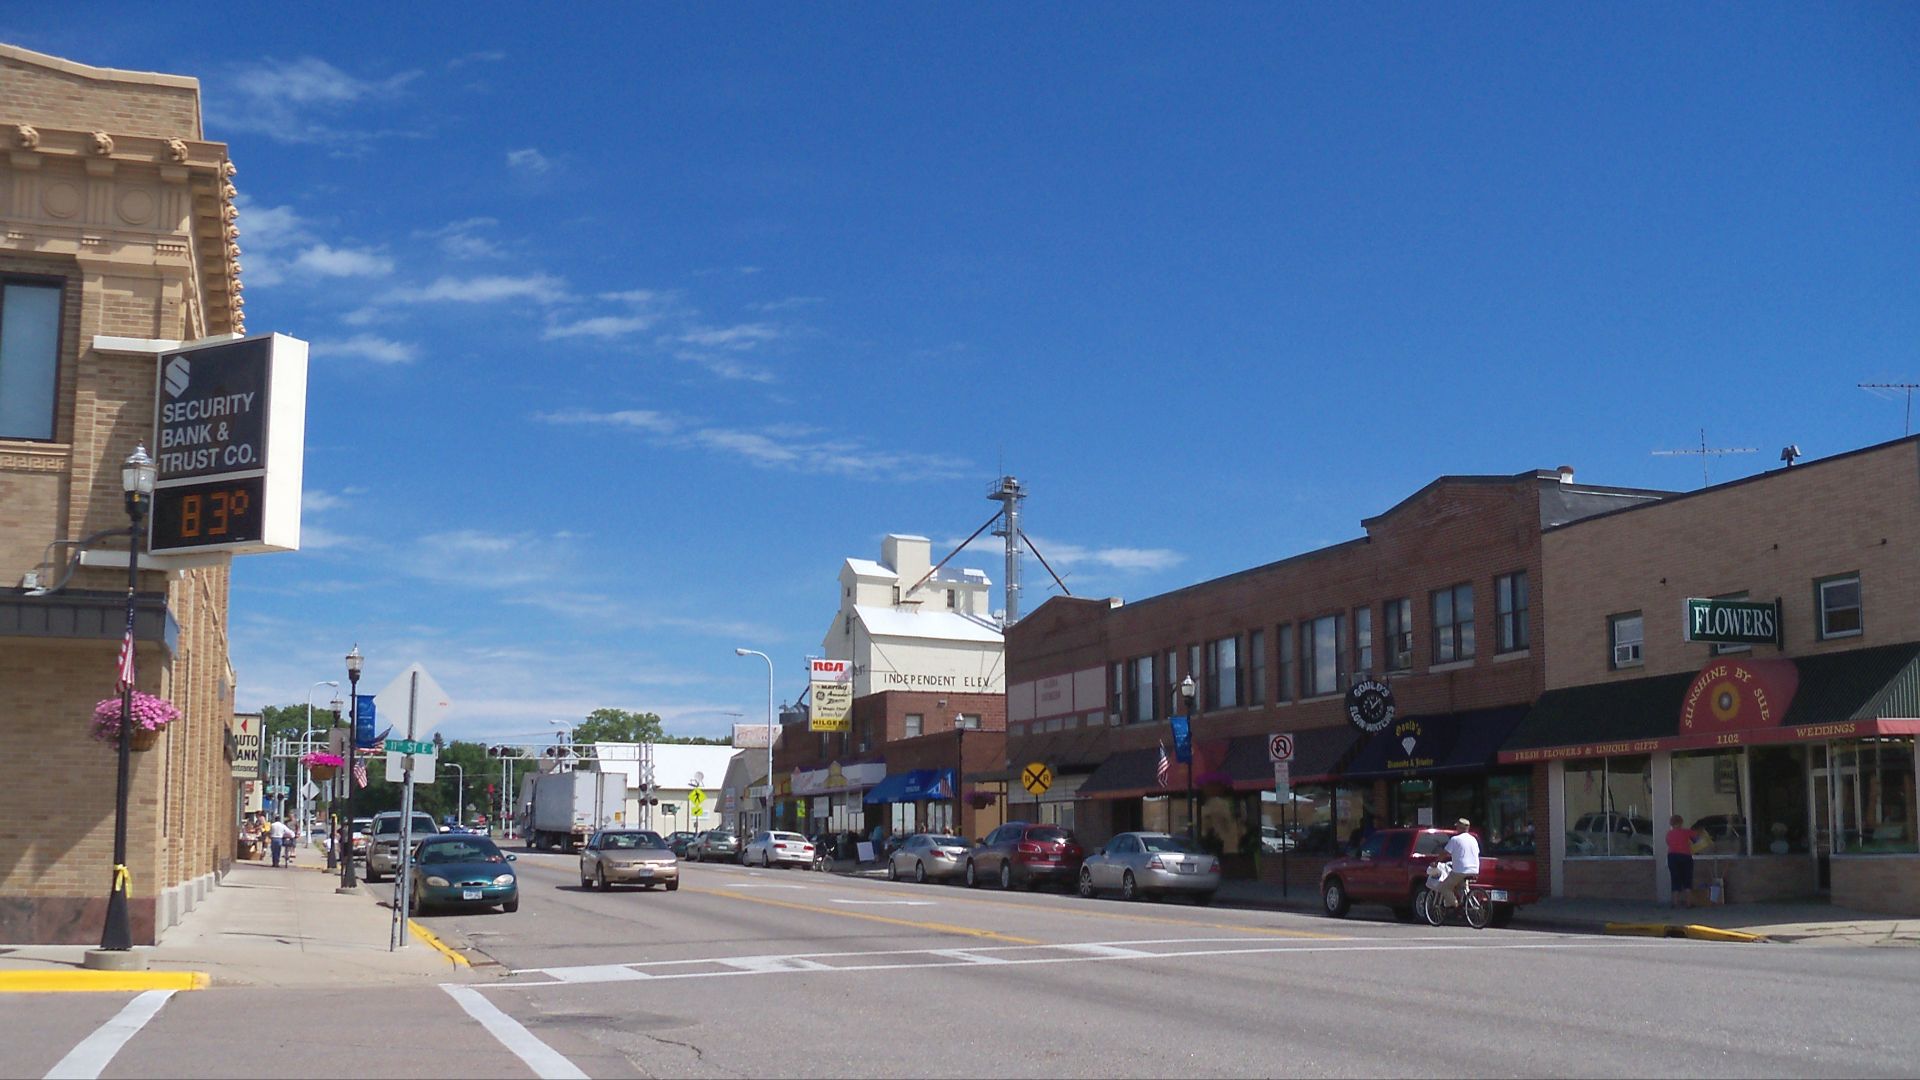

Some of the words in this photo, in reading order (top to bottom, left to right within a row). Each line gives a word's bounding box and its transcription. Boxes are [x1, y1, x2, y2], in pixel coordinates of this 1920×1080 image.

[162, 391, 255, 423] SECURITY
[161, 424, 212, 448] BANK
[217, 421, 229, 441] &
[160, 448, 219, 473] TRUST
[223, 443, 257, 466] CO.
[1694, 606, 1774, 637] FLOWERS
[813, 661, 844, 672] RCA
[884, 673, 956, 687] INDEPENDENT
[1685, 665, 1728, 728] SUNSHINE
[1735, 667, 1752, 683] BY
[1754, 687, 1770, 721] SUE
[1796, 723, 1856, 737] WEDDINGS
[1717, 734, 1739, 744] 1102
[407, 742, 417, 752] ST
[422, 744, 427, 752] E
[1515, 752, 1539, 760] FRESH
[1544, 748, 1582, 758] FLOWERS
[1596, 743, 1630, 753] UNIQUE
[1634, 741, 1659, 750] GIFTS
[237, 749, 258, 761] ANK
[1025, 775, 1031, 783] R
[1043, 774, 1049, 782] R
